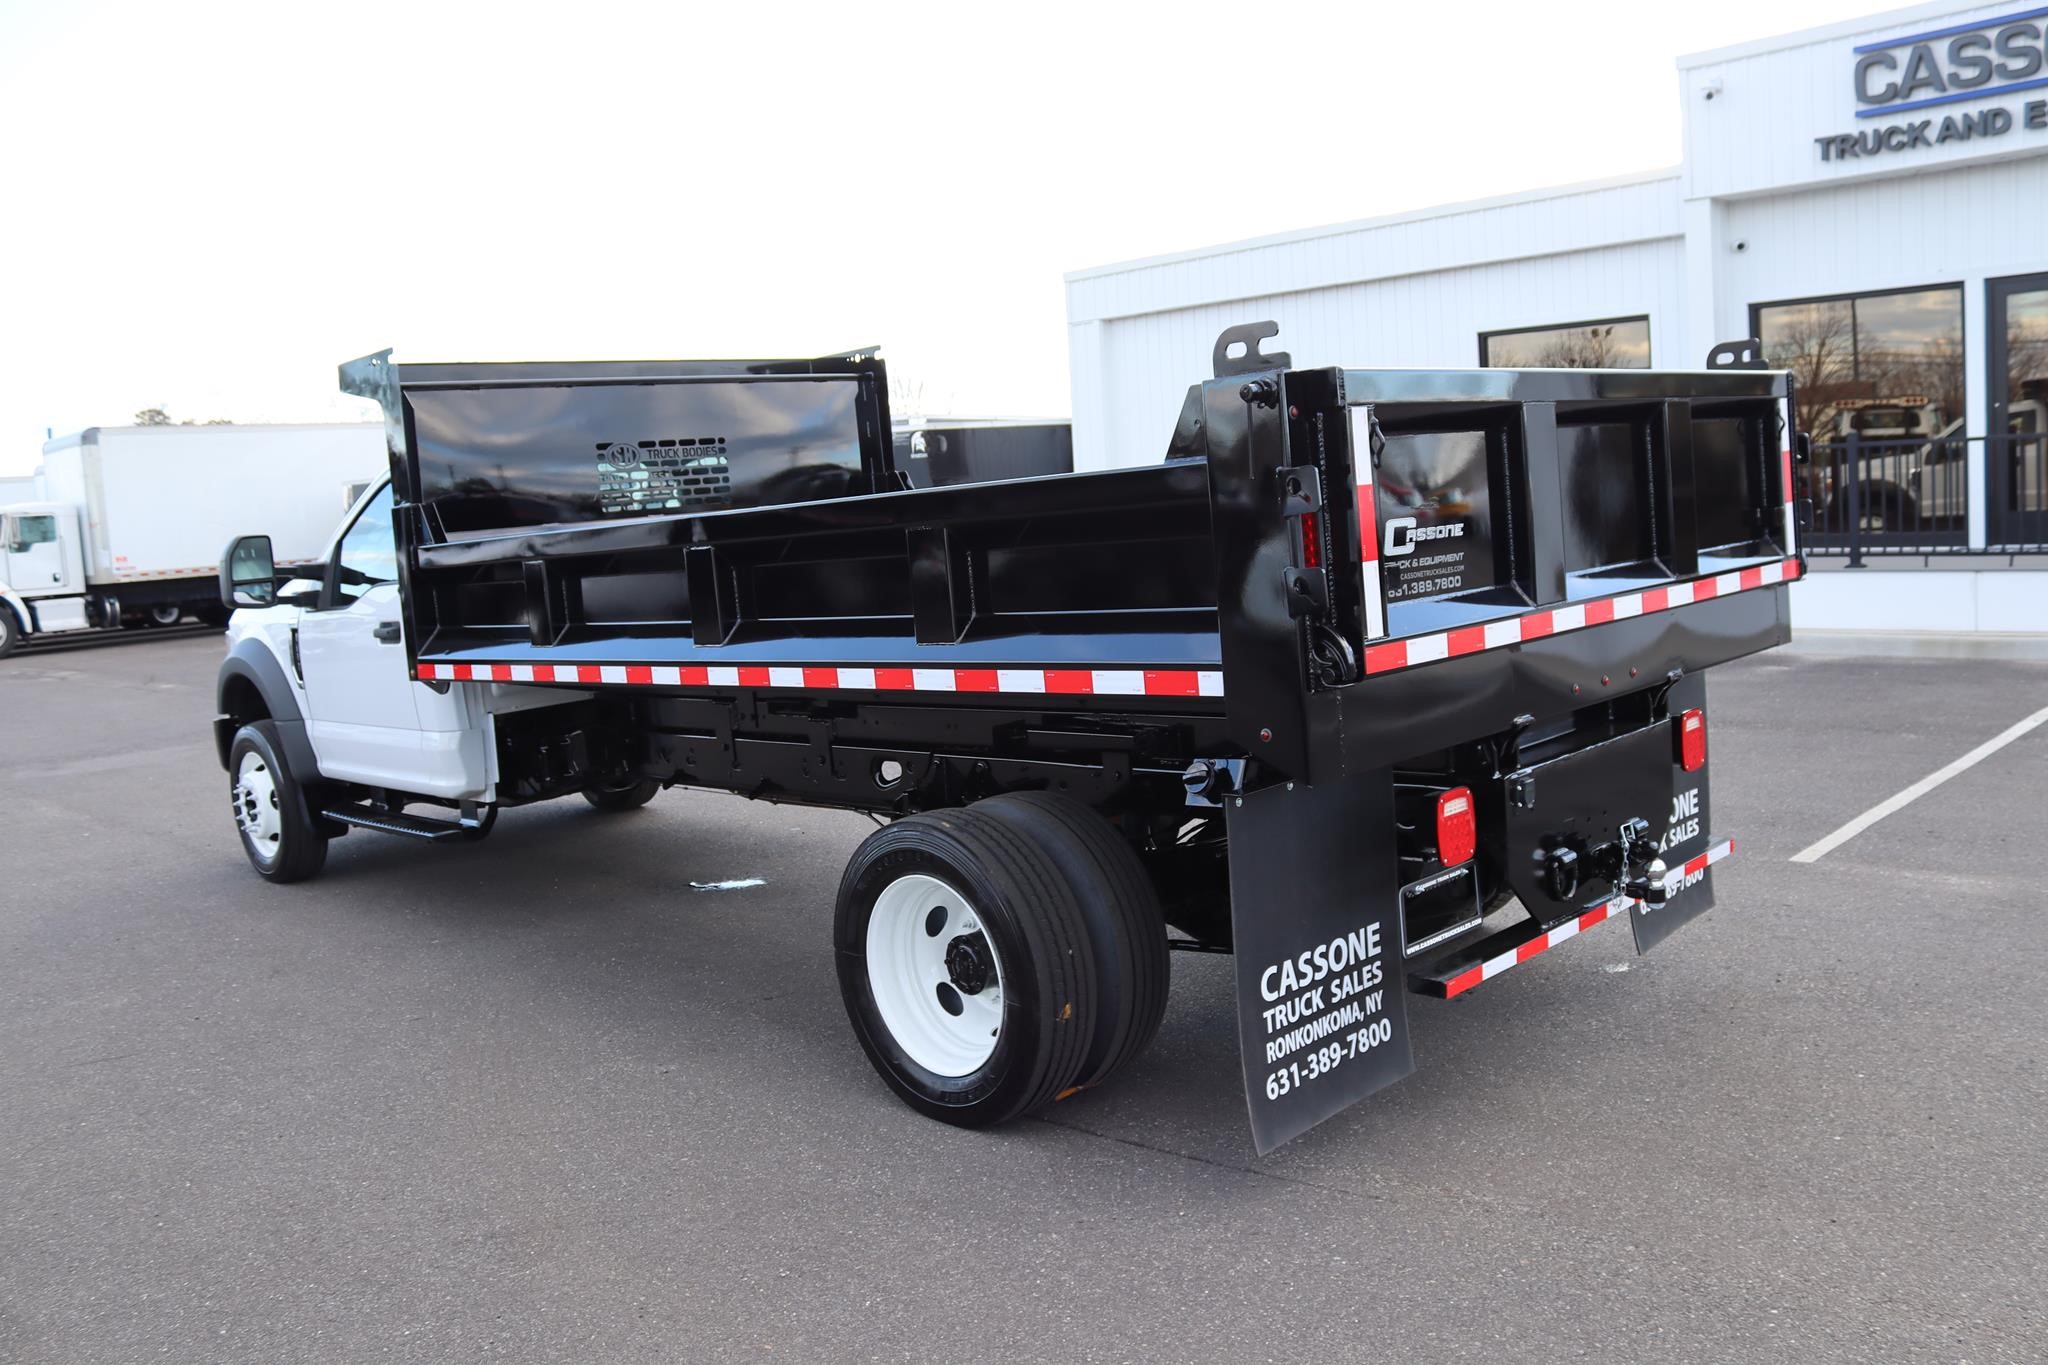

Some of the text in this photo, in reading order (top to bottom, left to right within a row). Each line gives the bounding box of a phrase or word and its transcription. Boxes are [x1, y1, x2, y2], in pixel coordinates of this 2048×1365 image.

[1855, 23, 2048, 104] CASS
[1814, 120, 1932, 161] TRUCK
[1935, 107, 2013, 144] AND
[647, 446, 718, 460] TRUCK BODIES
[1400, 565, 1464, 580] CASSONETRUCKSALES.COM
[1411, 558, 1418, 568] &
[1419, 552, 1464, 566] EQUIPMENT
[1669, 818, 1700, 847] SALES
[1261, 922, 1381, 1002] CASSONE
[1263, 960, 1383, 1034] TRUCK SALES
[1266, 990, 1384, 1063] RONKONKOMA, NY
[1266, 1018, 1391, 1100] 631-389-7800
